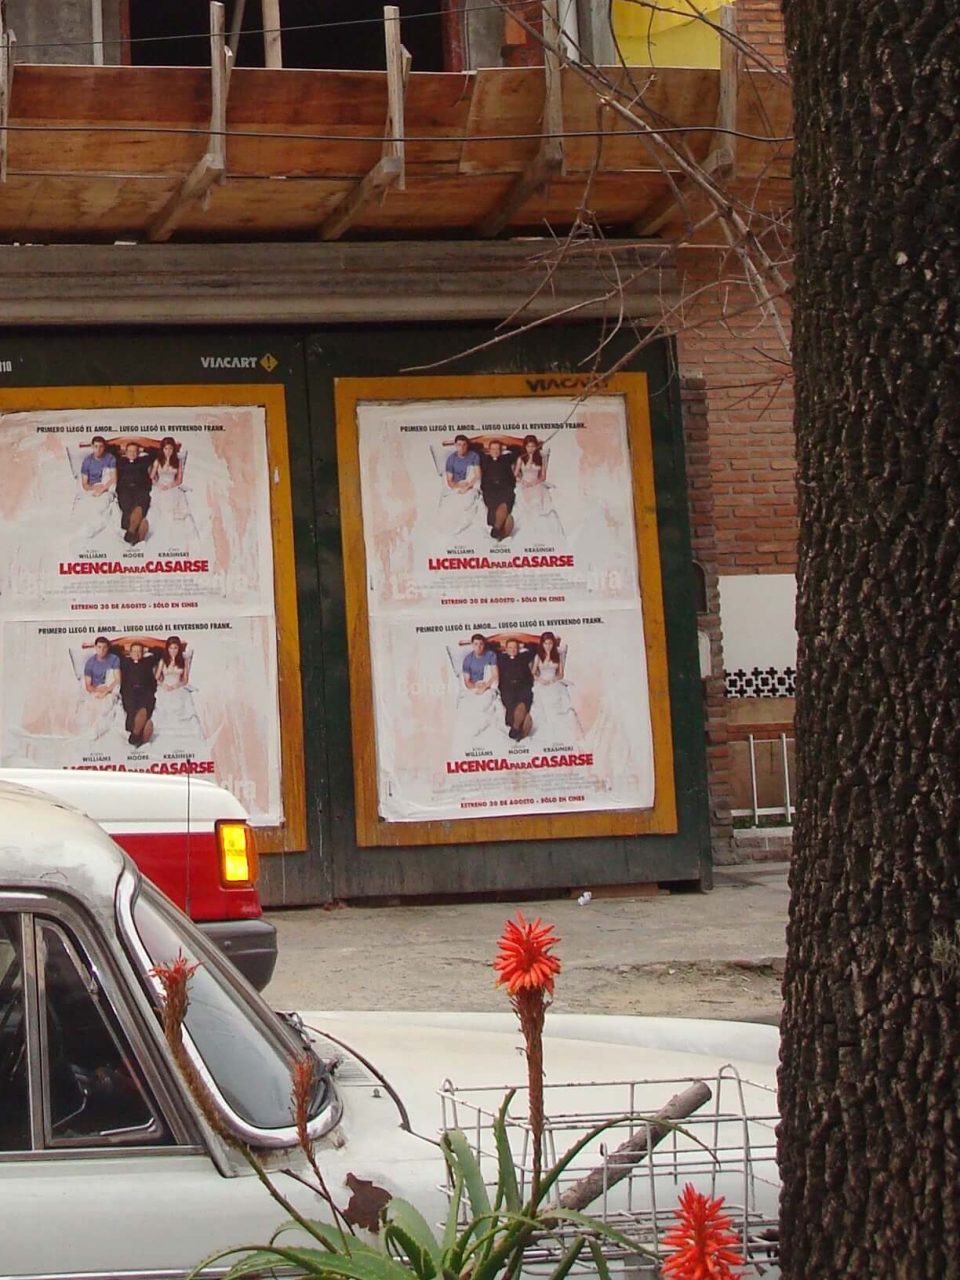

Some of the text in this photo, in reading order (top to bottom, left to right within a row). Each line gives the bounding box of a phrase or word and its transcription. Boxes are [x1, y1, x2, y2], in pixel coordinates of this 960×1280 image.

[201, 356, 257, 368] VIACART
[59, 563, 123, 574] LICENCIA
[145, 560, 209, 572] CASARSE
[429, 557, 490, 570] LICENCIA
[512, 556, 574, 568] CASARSE
[69, 626, 87, 634] LLEGÓ
[150, 762, 215, 774] CASARSE
[447, 754, 593, 773] LICENCIA PARA CASARSE
